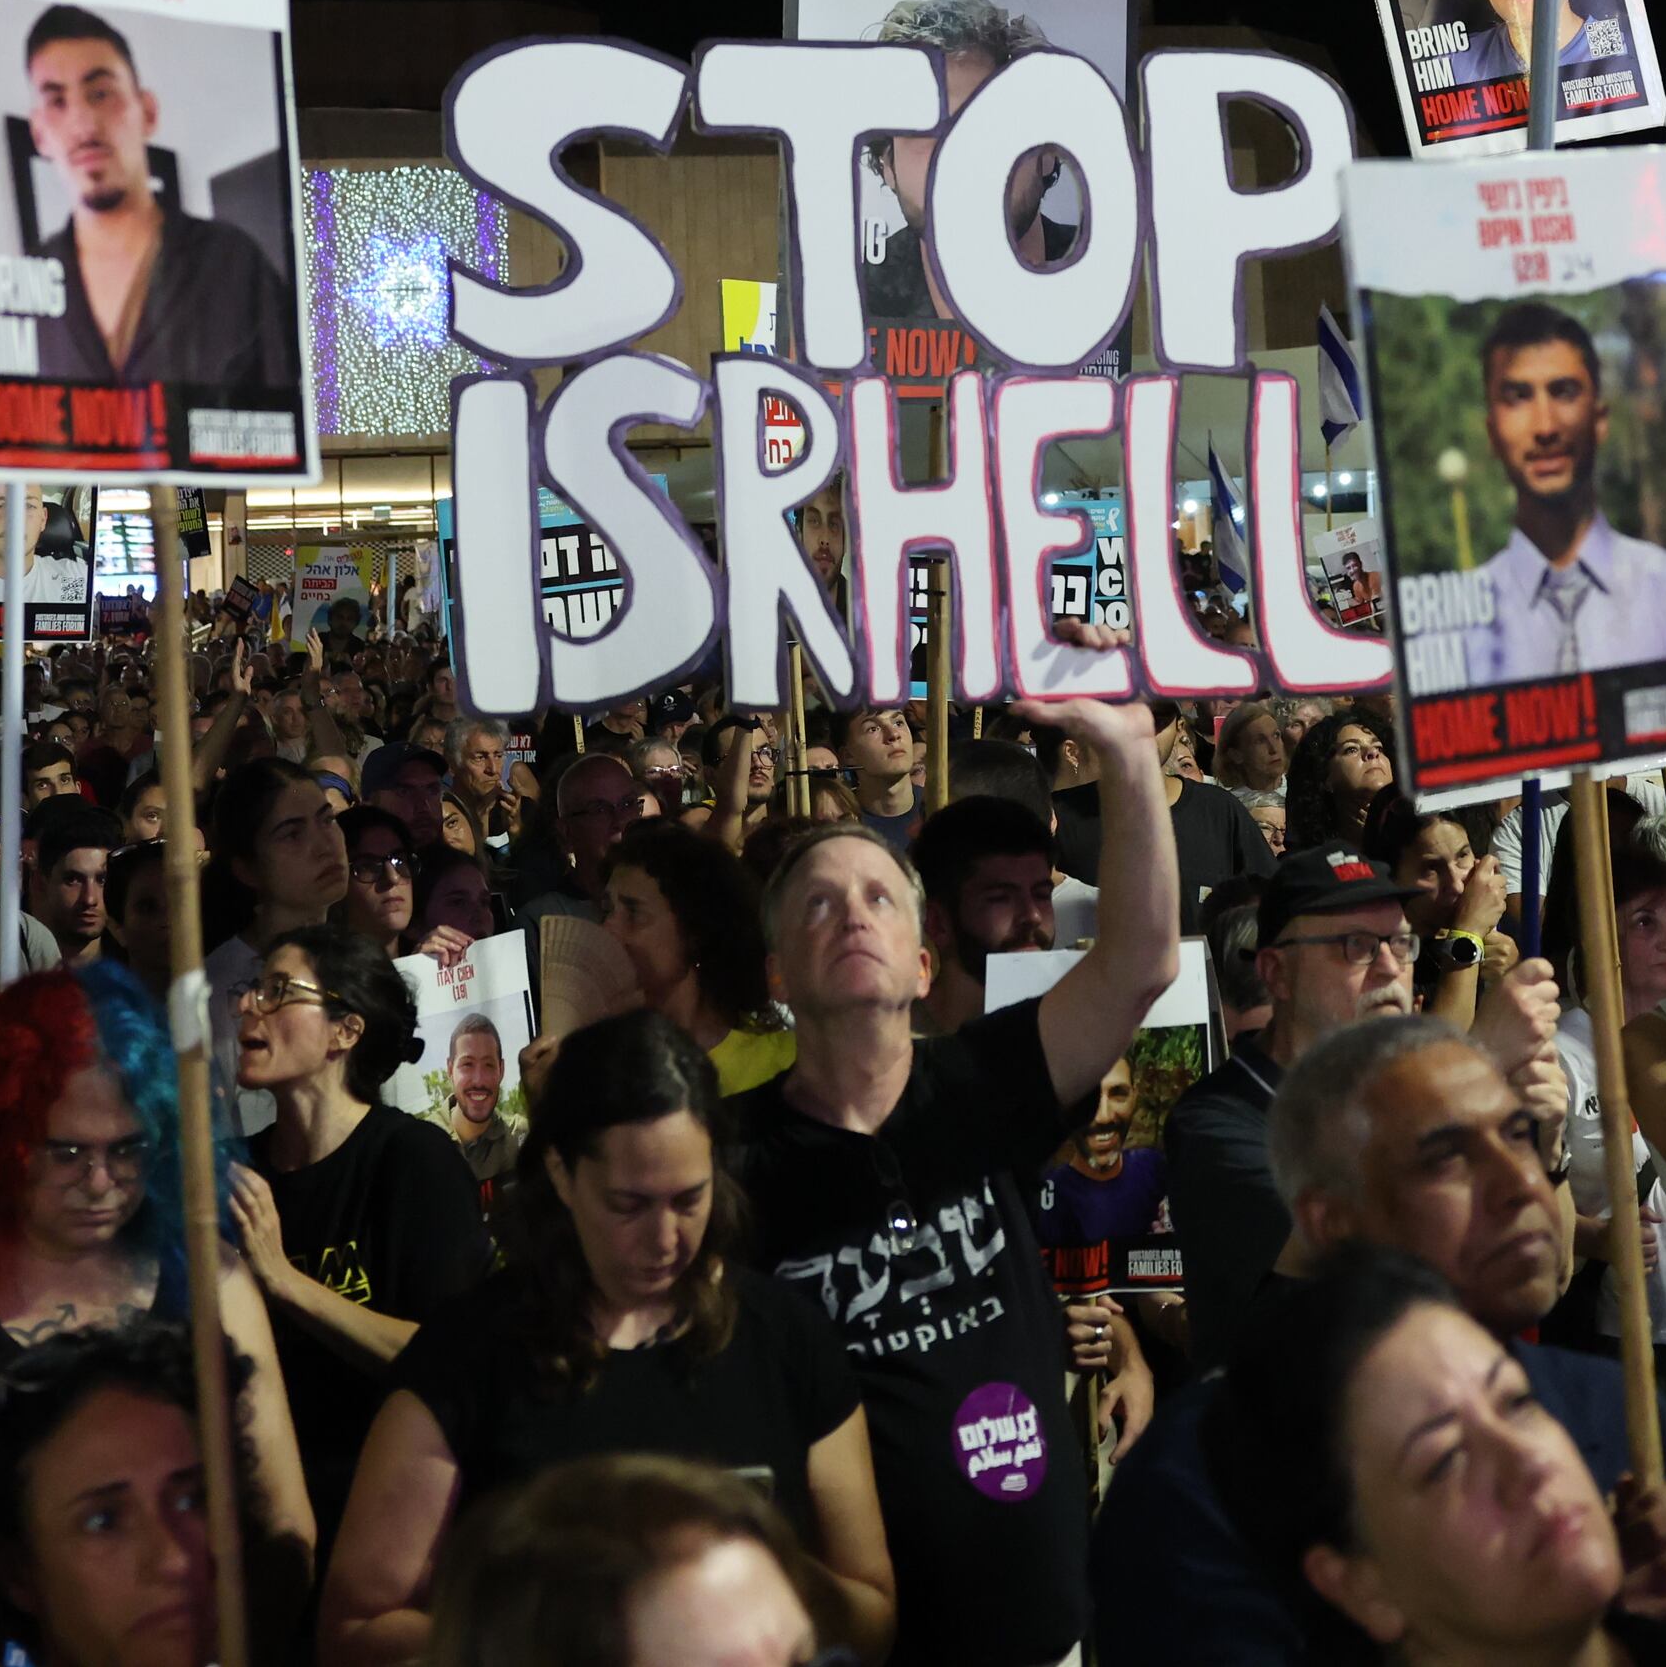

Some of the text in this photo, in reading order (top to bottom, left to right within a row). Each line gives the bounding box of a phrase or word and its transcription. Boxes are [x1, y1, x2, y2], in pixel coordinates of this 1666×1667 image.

[1406, 20, 1470, 60] BRING
[1411, 57, 1456, 92] HIM
[1562, 70, 1633, 93] HOSTAGES MISSING
[1564, 81, 1637, 106] FAMILIES FORUM
[1421, 90, 1482, 128] HOME
[443, 35, 1357, 376] STOP
[71, 381, 167, 448] NOW!
[305, 562, 360, 578] אלון אהל
[1401, 573, 1494, 634] BRING
[34, 621, 85, 632] FAMILIES FORUM
[1405, 632, 1469, 697] HIM
[1411, 694, 1501, 762] HOME
[1506, 675, 1598, 751] NOW!
[457, 963, 474, 981] CHEN
[1054, 1240, 1109, 1279] NOW!
[1128, 1261, 1168, 1276] FAMILIES
[958, 1412, 1015, 1451] שלום
